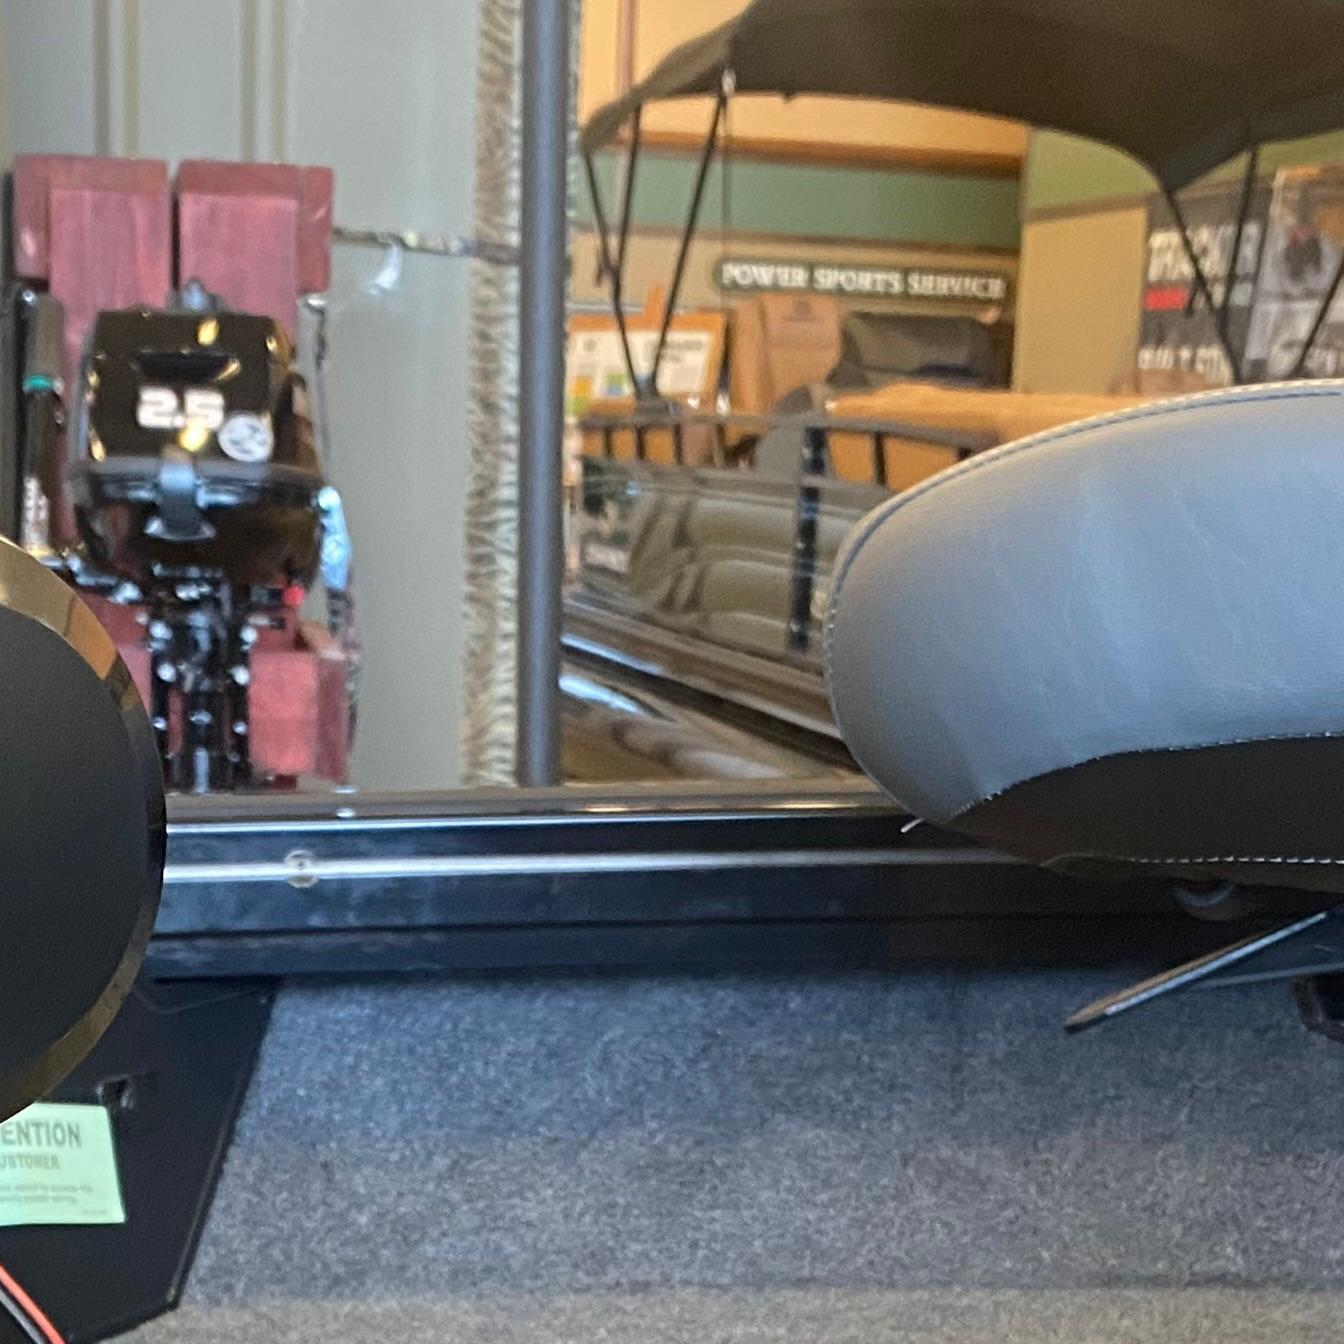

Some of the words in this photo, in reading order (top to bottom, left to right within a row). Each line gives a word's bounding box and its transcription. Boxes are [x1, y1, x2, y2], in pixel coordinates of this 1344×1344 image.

[721, 261, 807, 288] POWER
[812, 267, 904, 294] SPORTS
[907, 271, 1006, 299] SERVICE
[137, 386, 225, 430] 2.5
